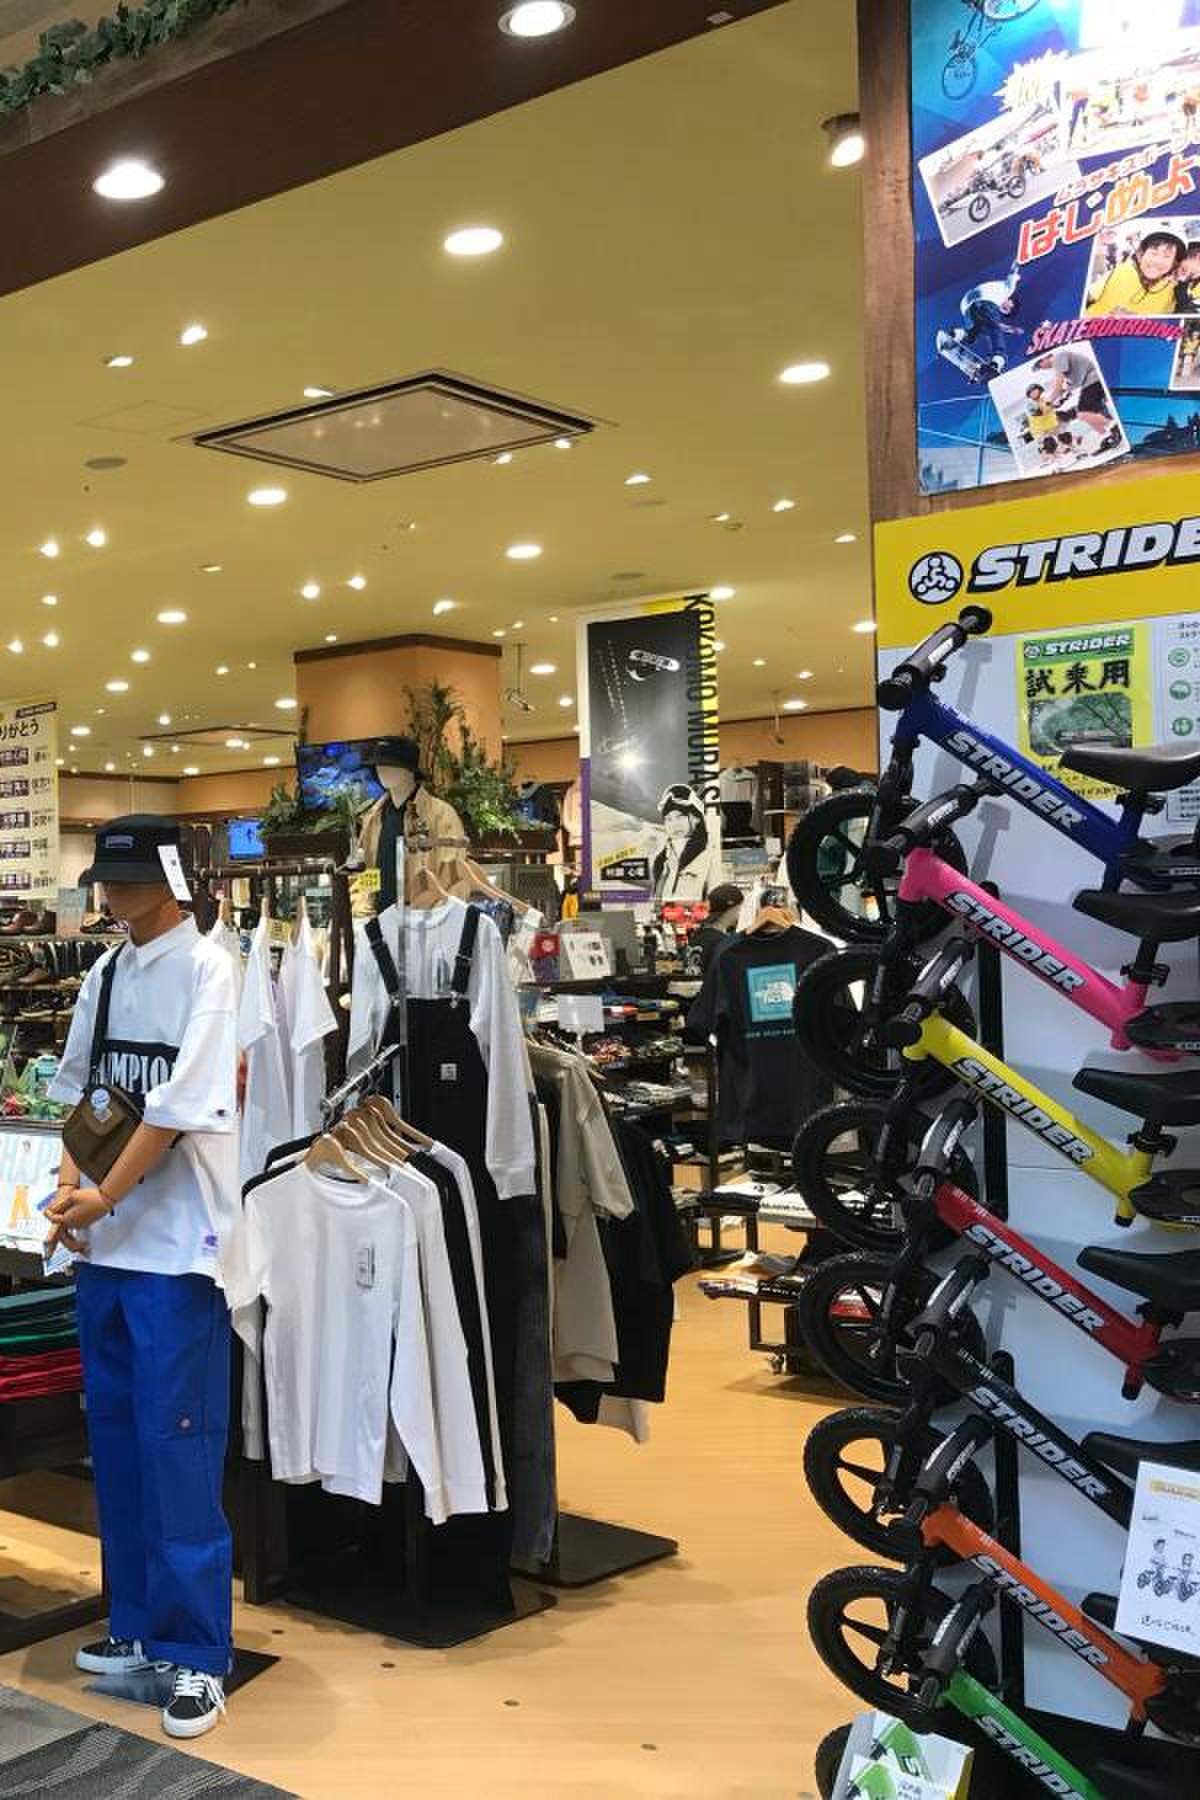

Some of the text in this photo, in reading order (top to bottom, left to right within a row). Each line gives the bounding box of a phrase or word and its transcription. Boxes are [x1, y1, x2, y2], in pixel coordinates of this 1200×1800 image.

[1026, 318, 1184, 355] SKATEBOARDING
[1026, 658, 1131, 698] 試乗用
[1044, 633, 1131, 657] STRIDER
[947, 731, 1087, 831] STRIDER
[947, 893, 1085, 993] STRIDER
[956, 1057, 1095, 1164] STRIDER
[965, 1224, 1107, 1333] STRIDER
[971, 1386, 1112, 1498] STRIDER
[971, 1555, 1112, 1666] STRIDER
[973, 1715, 1087, 1800] STRID
